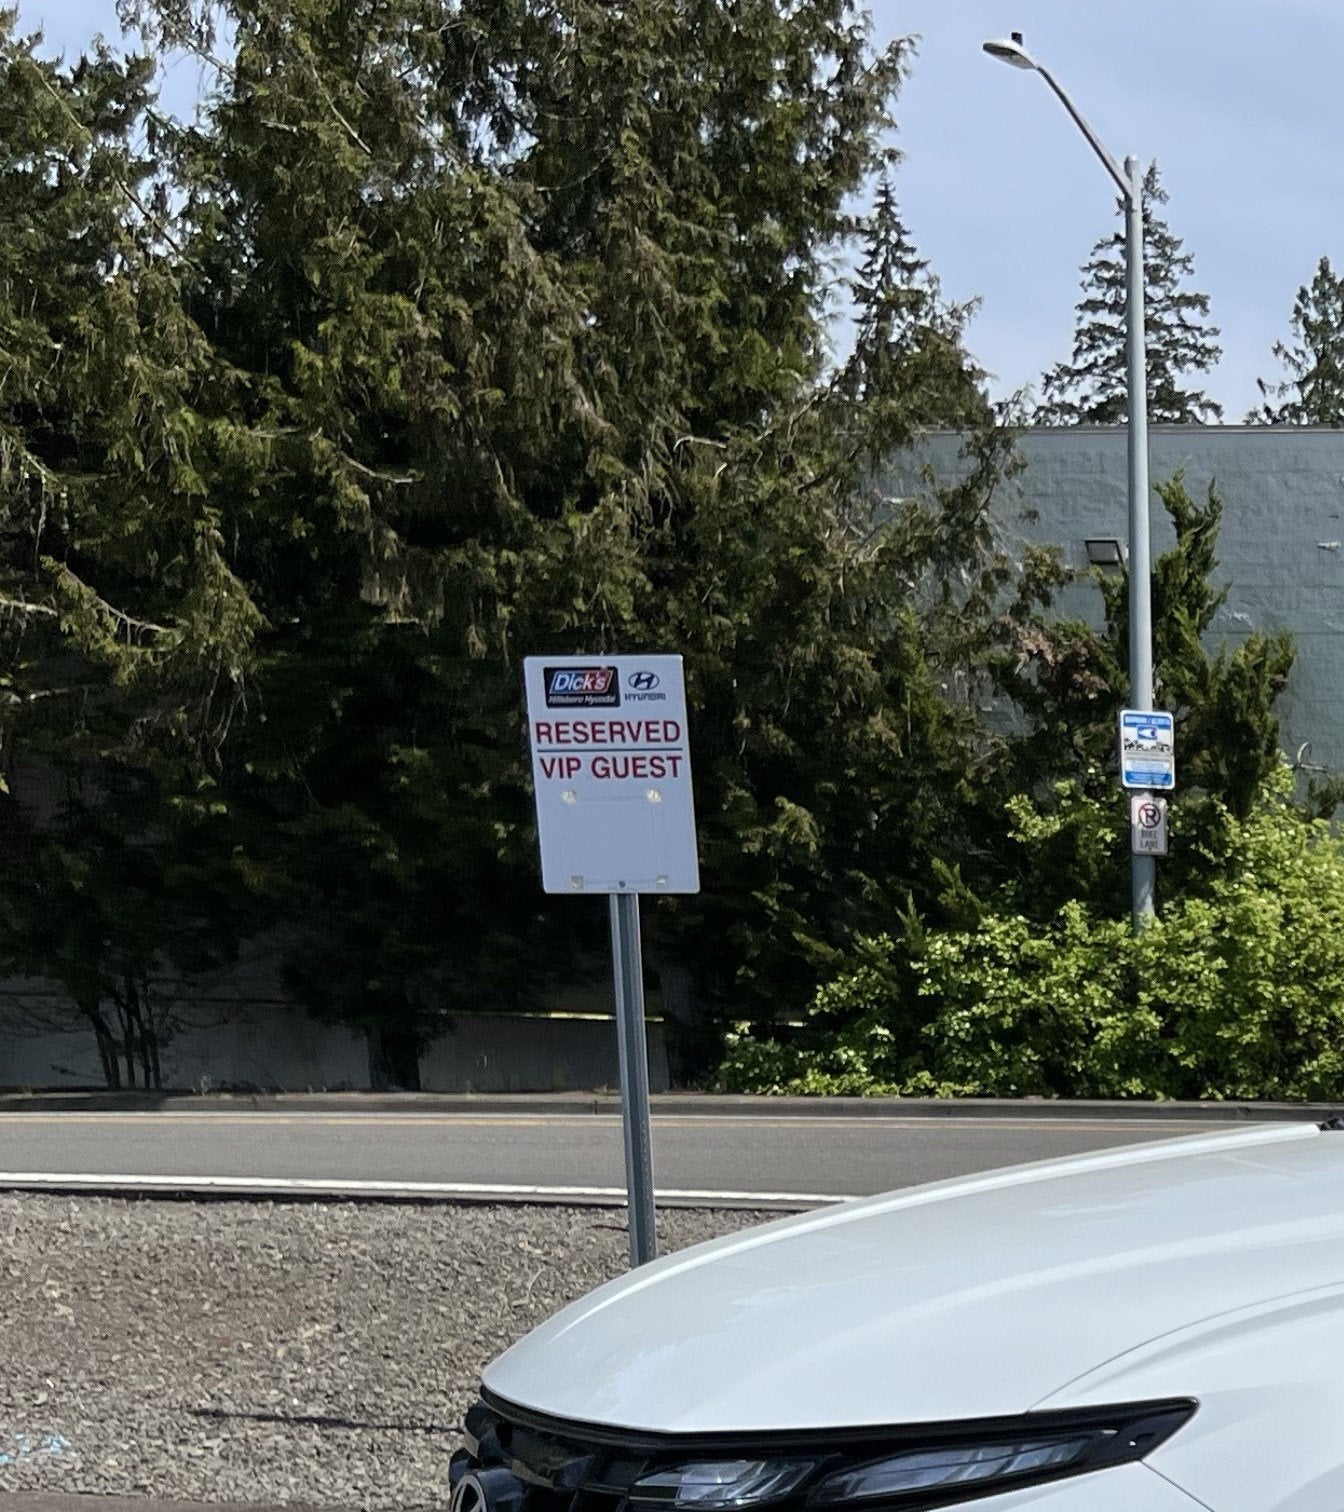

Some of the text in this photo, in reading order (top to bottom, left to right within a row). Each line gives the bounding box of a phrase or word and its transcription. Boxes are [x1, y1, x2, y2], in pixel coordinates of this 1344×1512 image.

[535, 721, 681, 744] RESERVED
[540, 756, 683, 779] VIP GUEST
